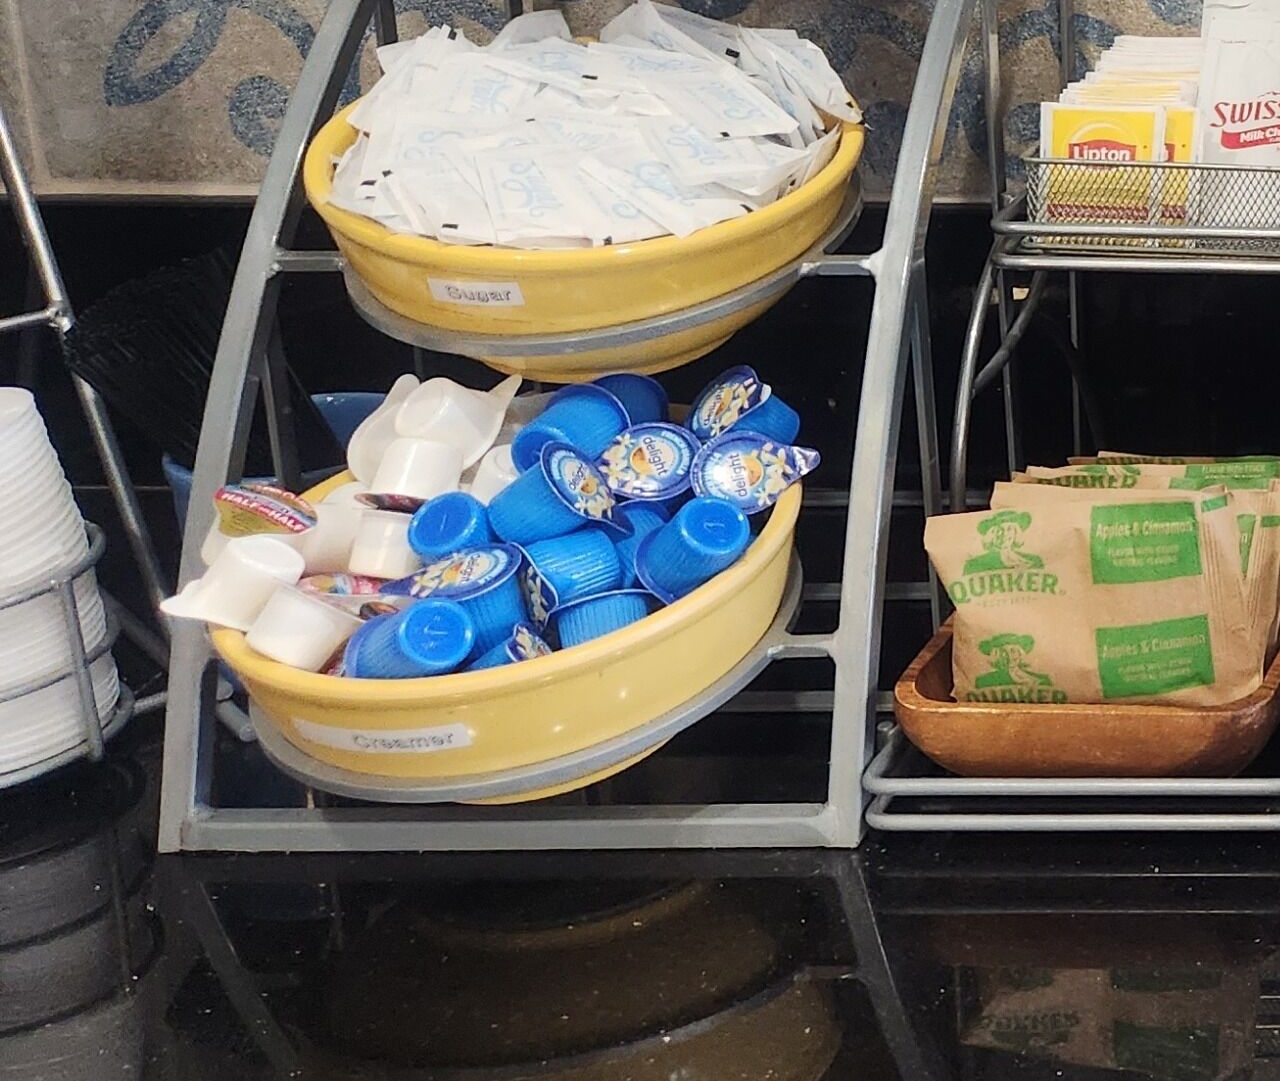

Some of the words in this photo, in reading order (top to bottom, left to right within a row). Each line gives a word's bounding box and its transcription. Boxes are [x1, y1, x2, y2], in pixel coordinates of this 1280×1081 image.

[1239, 130, 1265, 144] Milk
[1073, 145, 1131, 162] Lipton
[444, 284, 512, 303] Sugar
[641, 435, 668, 477] delight
[729, 451, 747, 498] delight
[220, 492, 259, 510] HALF
[267, 509, 306, 532] HALF
[1096, 521, 1131, 541] Apples
[1142, 519, 1194, 536] Cinnamon
[949, 571, 1059, 604] QUAKER
